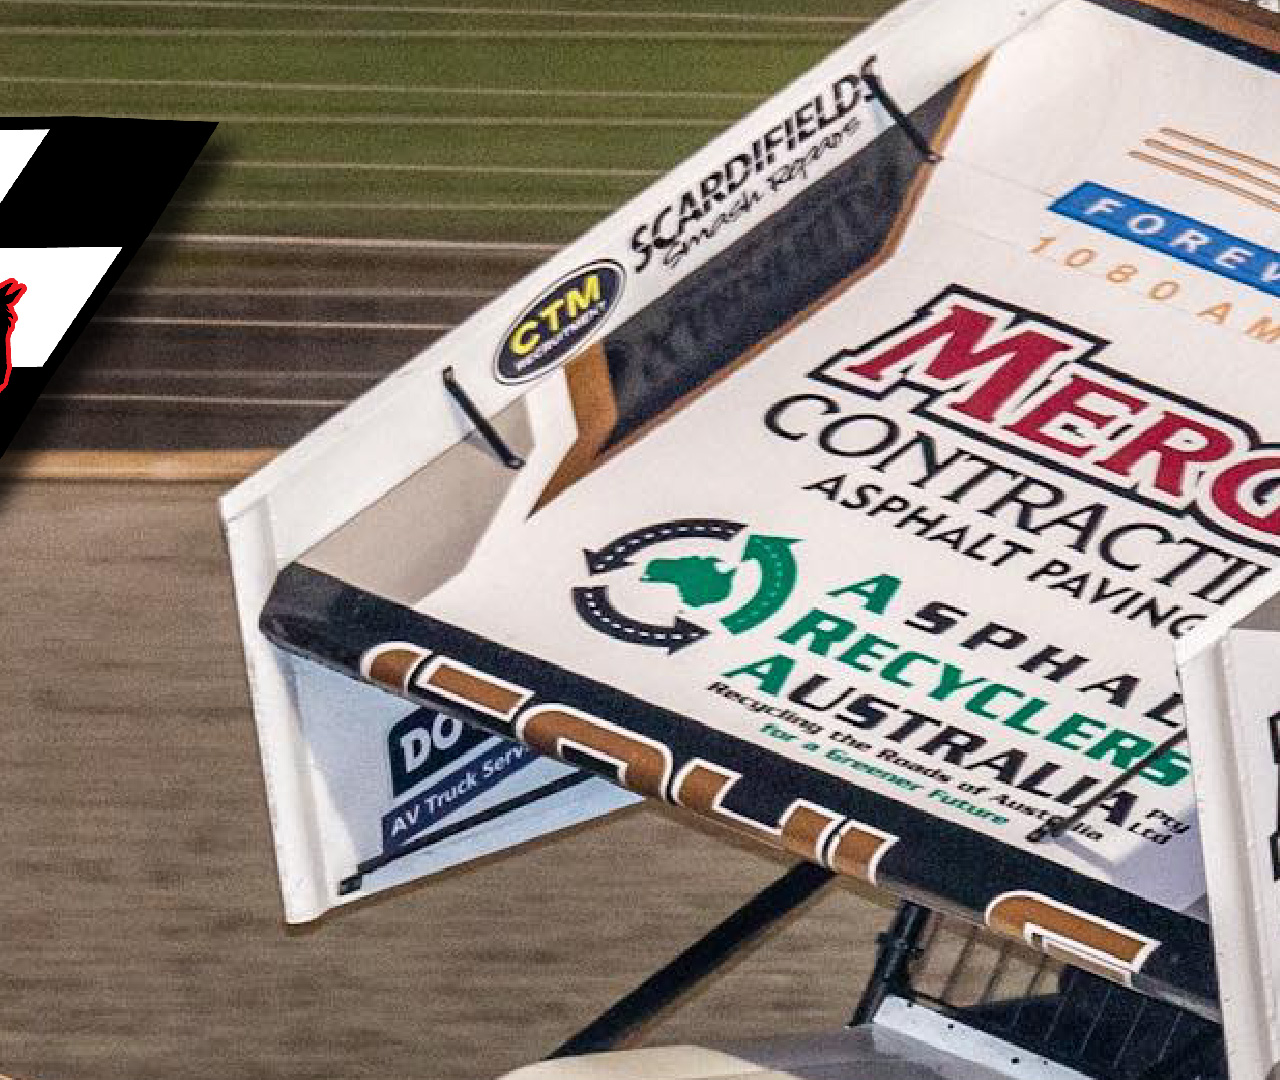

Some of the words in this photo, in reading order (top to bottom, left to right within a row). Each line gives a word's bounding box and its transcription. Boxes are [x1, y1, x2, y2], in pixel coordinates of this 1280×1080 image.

[508, 274, 601, 356] CTM
[1028, 235, 1181, 303] 1080
[801, 474, 1019, 567] ASPHALT
[1026, 557, 1208, 641] PAVING
[706, 679, 823, 736] Recycling
[828, 730, 872, 753] the
[877, 746, 954, 784] Roads
[958, 780, 988, 797] of
[990, 794, 1105, 843] Austlia
[721, 653, 1142, 827] AUSTRALIA
[776, 607, 1192, 789] RECYCLERS
[423, 772, 477, 814] Truck
[759, 722, 800, 749] for
[825, 747, 919, 793] Greener
[926, 787, 1011, 826] Future
